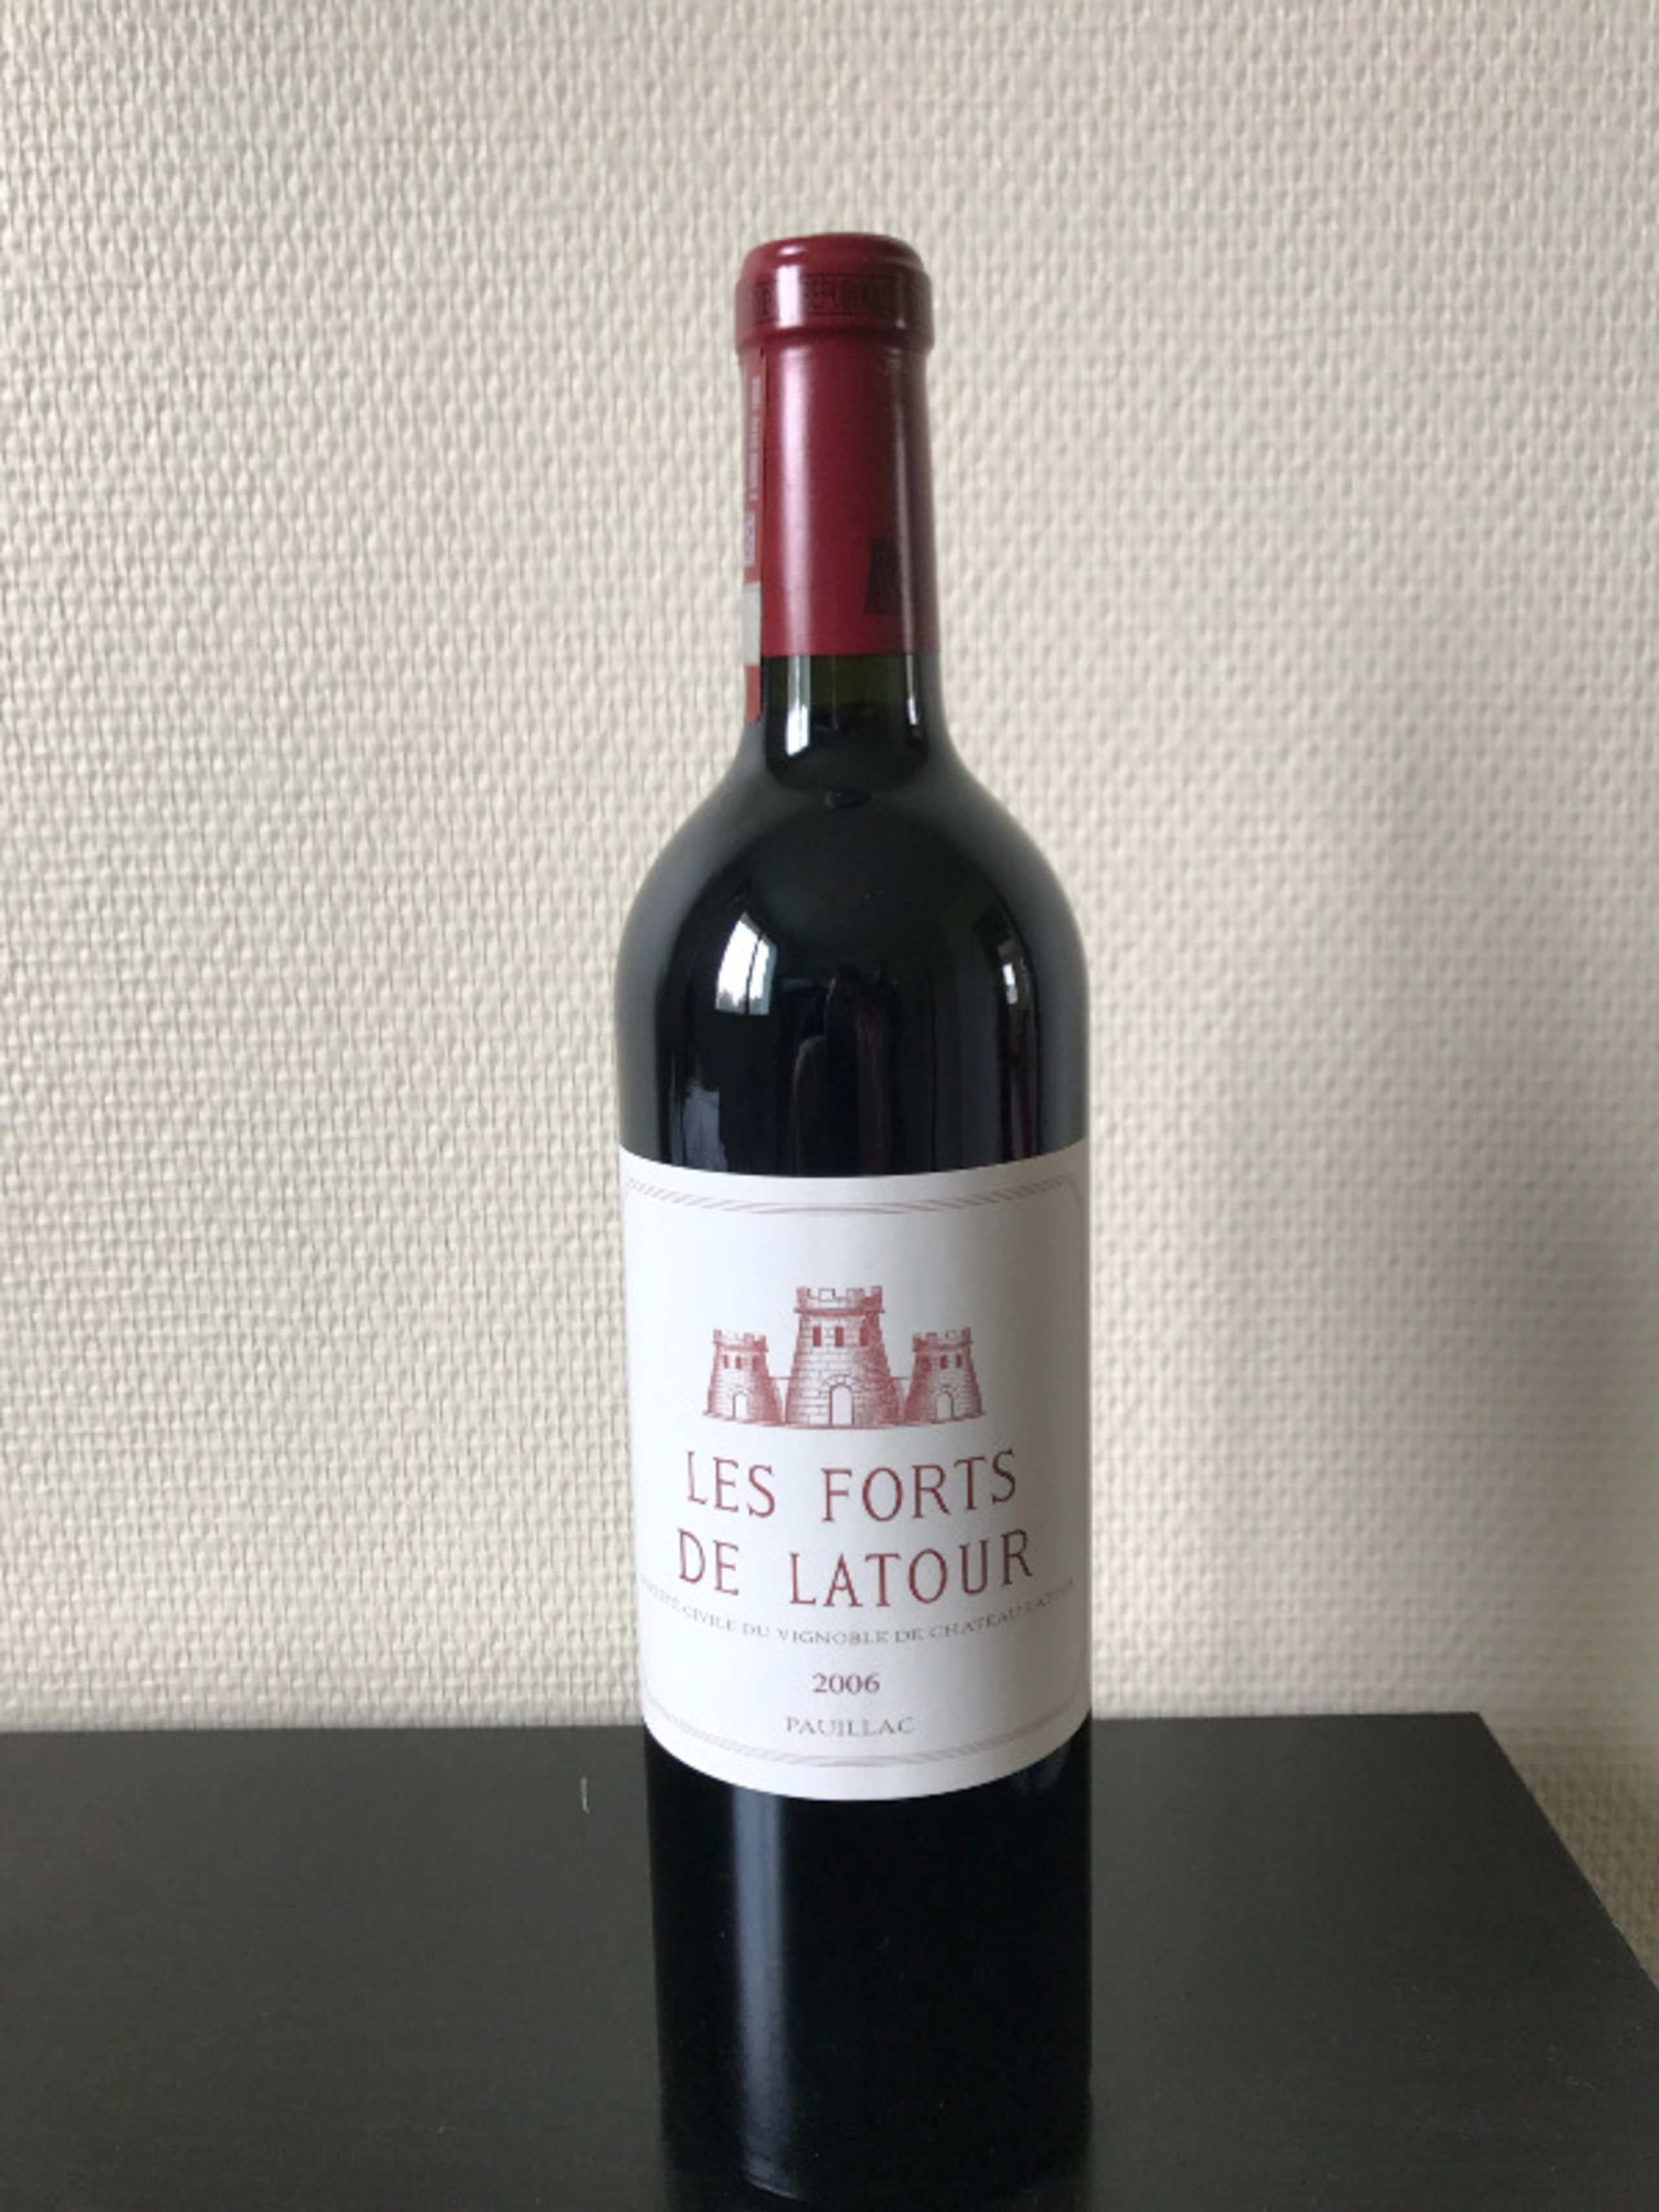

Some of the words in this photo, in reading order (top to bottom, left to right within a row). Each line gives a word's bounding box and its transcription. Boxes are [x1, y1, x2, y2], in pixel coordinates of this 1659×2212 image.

[688, 1450, 776, 1519] LES
[821, 1449, 1017, 1522] FORTS
[679, 1527, 739, 1596] DE
[789, 1528, 1034, 1607] LATOUR
[682, 1606, 737, 1633] CIVILE
[743, 1622, 770, 1638] DU
[778, 1627, 888, 1646] VIGNOBLE
[895, 1629, 924, 1644] DE
[812, 1671, 880, 1695] 2006
[785, 1716, 918, 1738] PAUILLAC
